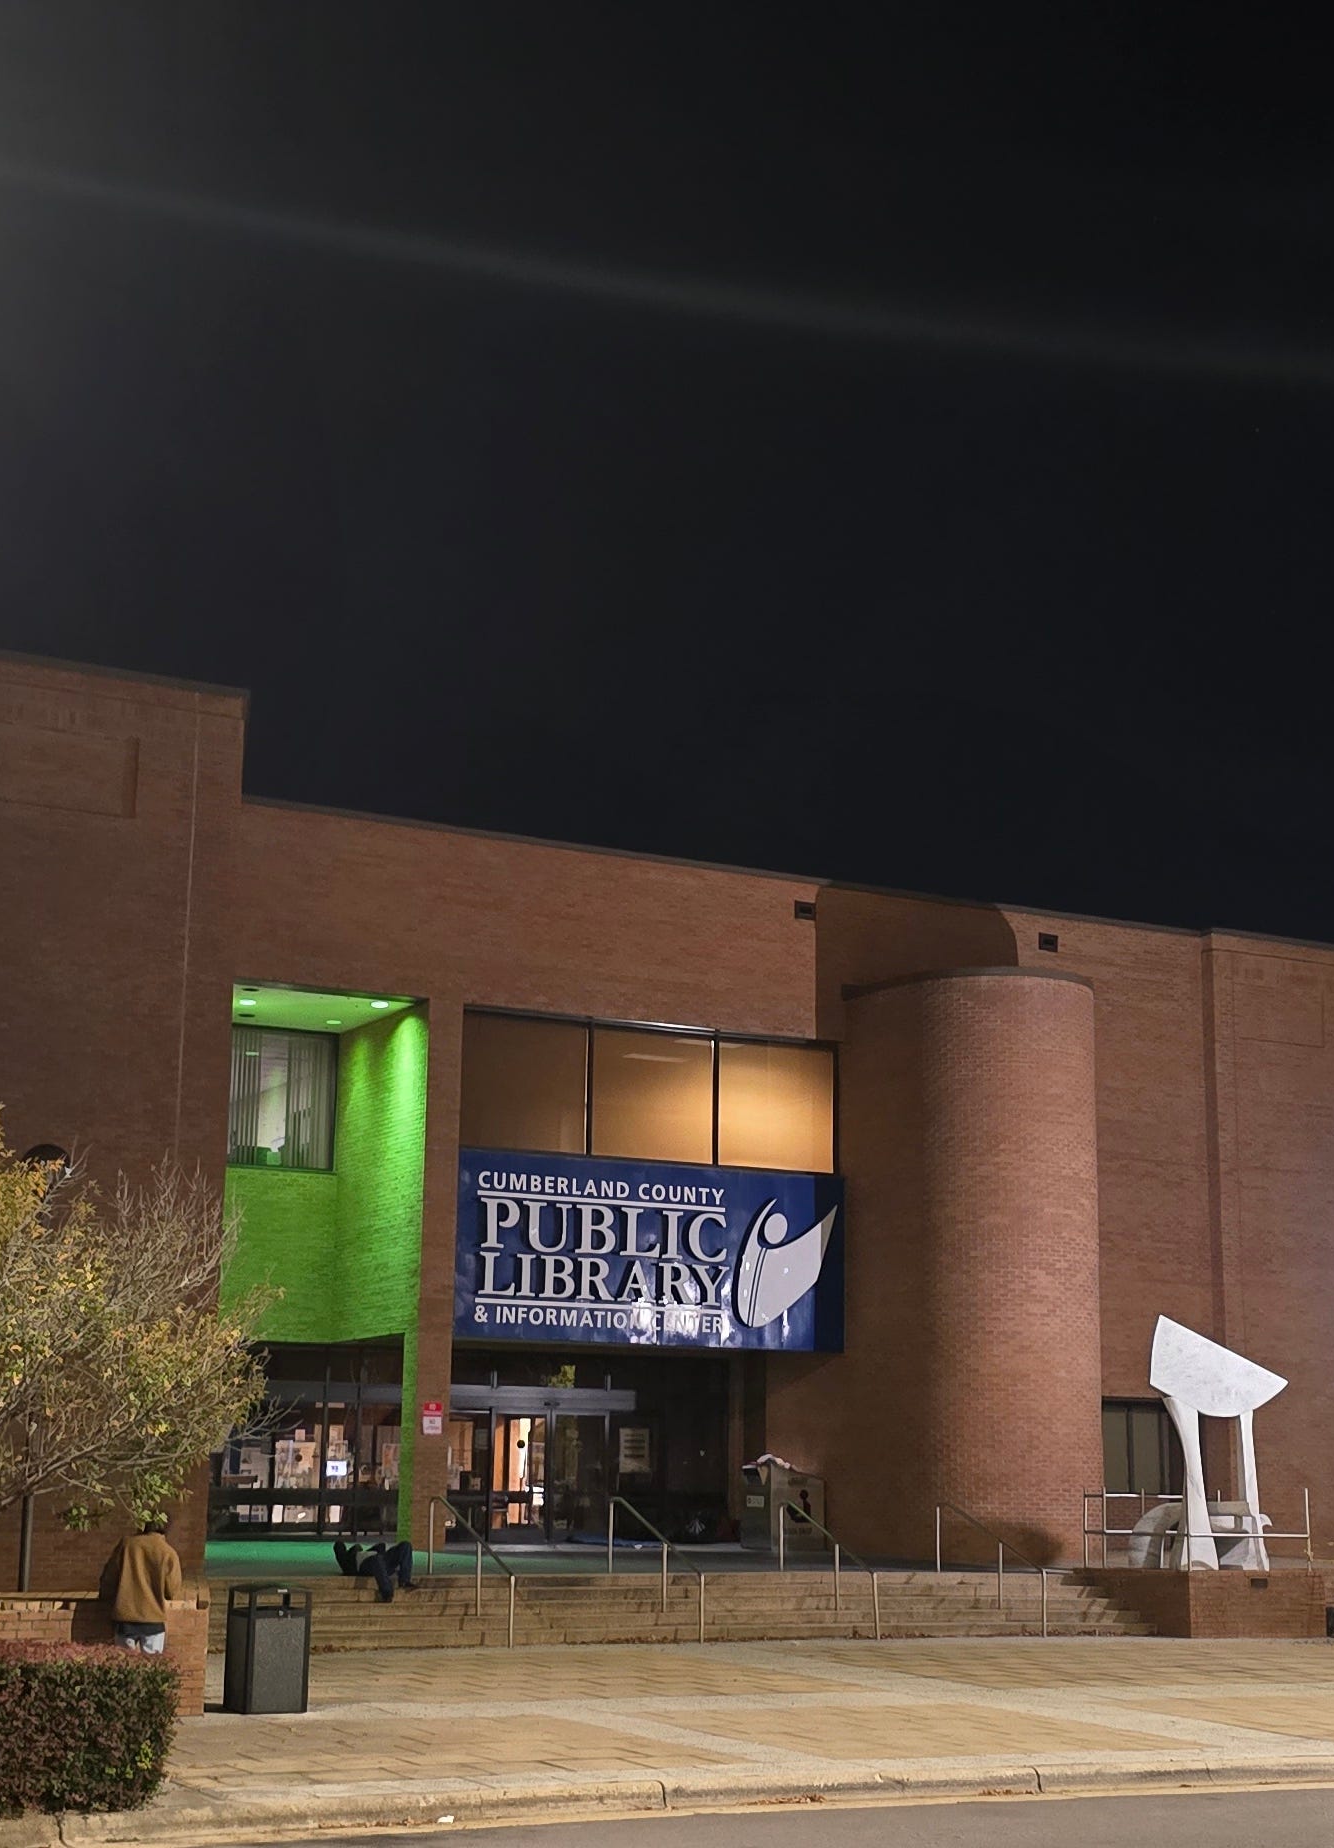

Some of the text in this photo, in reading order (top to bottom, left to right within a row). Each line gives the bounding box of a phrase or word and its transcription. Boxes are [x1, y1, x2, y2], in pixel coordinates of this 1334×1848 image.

[478, 1171, 726, 1205] CUMBERLAND COUNTY
[480, 1198, 728, 1263] PUBLIC
[478, 1251, 729, 1306] LIBRARY
[474, 1305, 723, 1334] & INFORMATION CNTER
